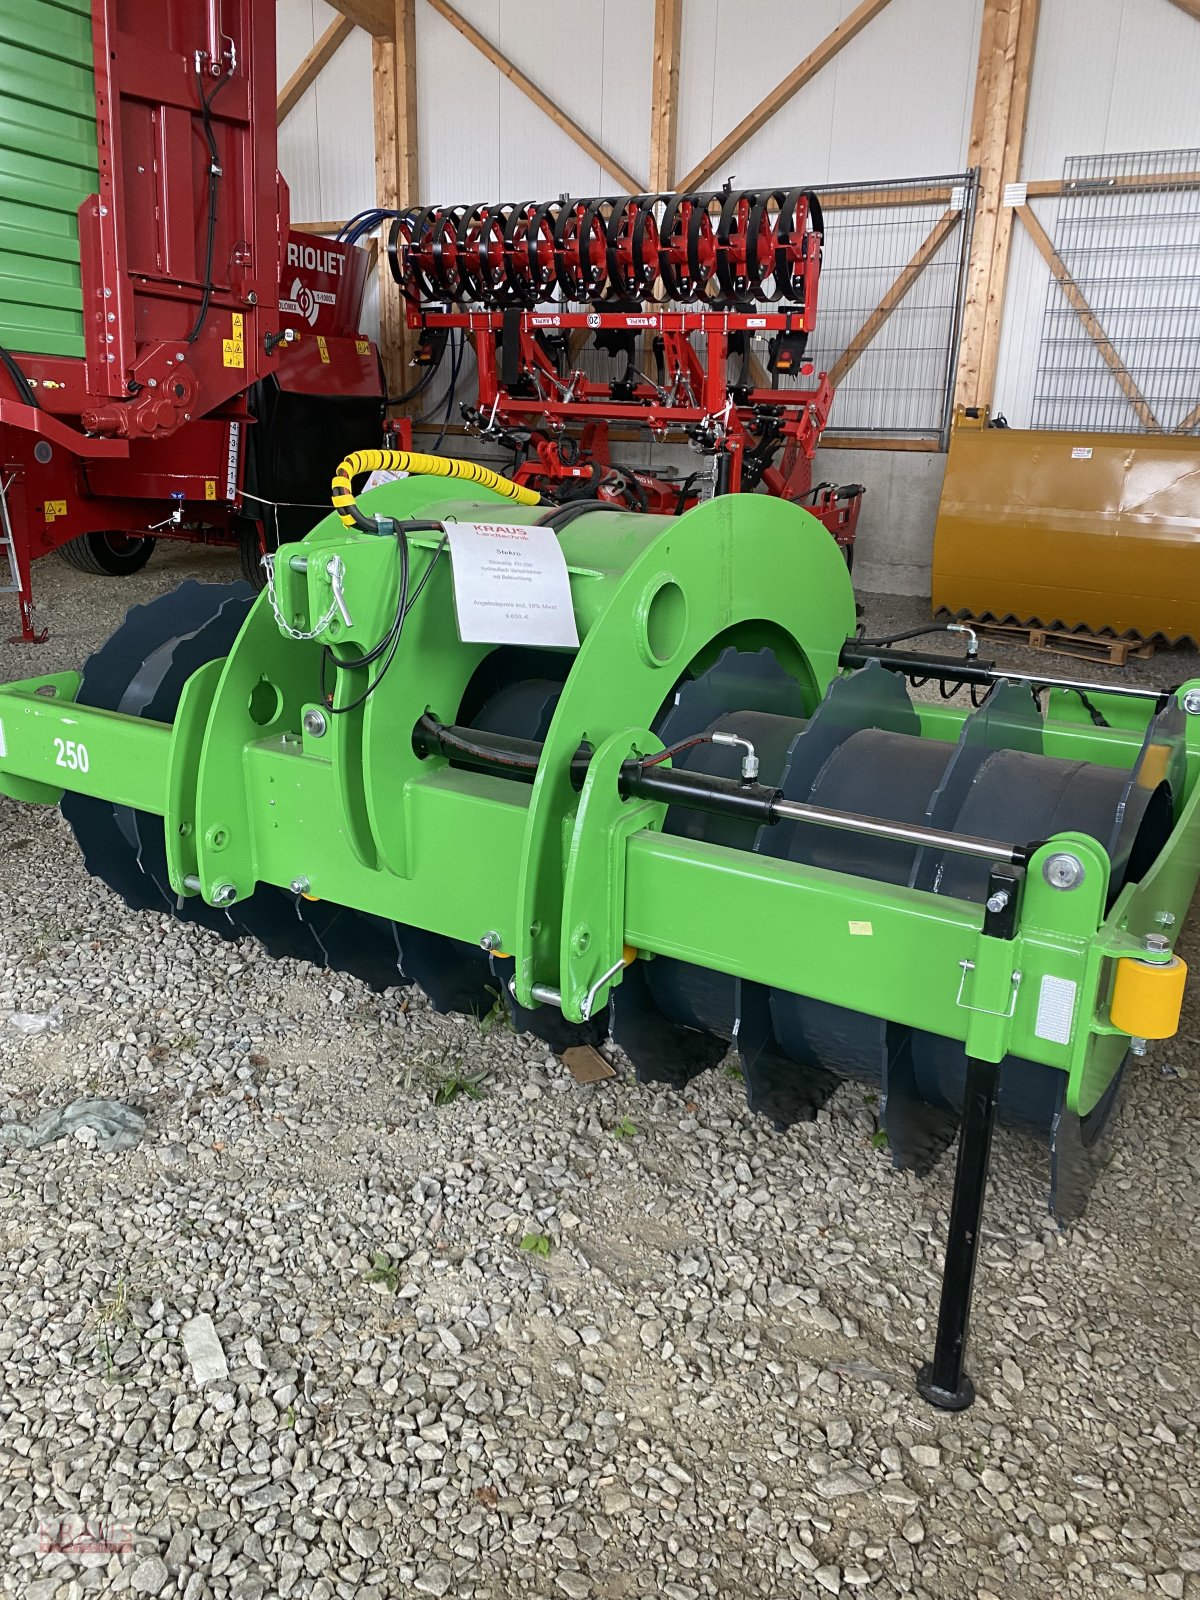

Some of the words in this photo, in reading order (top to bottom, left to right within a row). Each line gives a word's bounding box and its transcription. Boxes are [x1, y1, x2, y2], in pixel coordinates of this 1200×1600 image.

[588, 316, 599, 325] 20
[473, 524, 528, 536] KRAUS
[476, 531, 529, 541] Landtechnik
[496, 548, 522, 557] Stekro
[53, 737, 89, 773] 250
